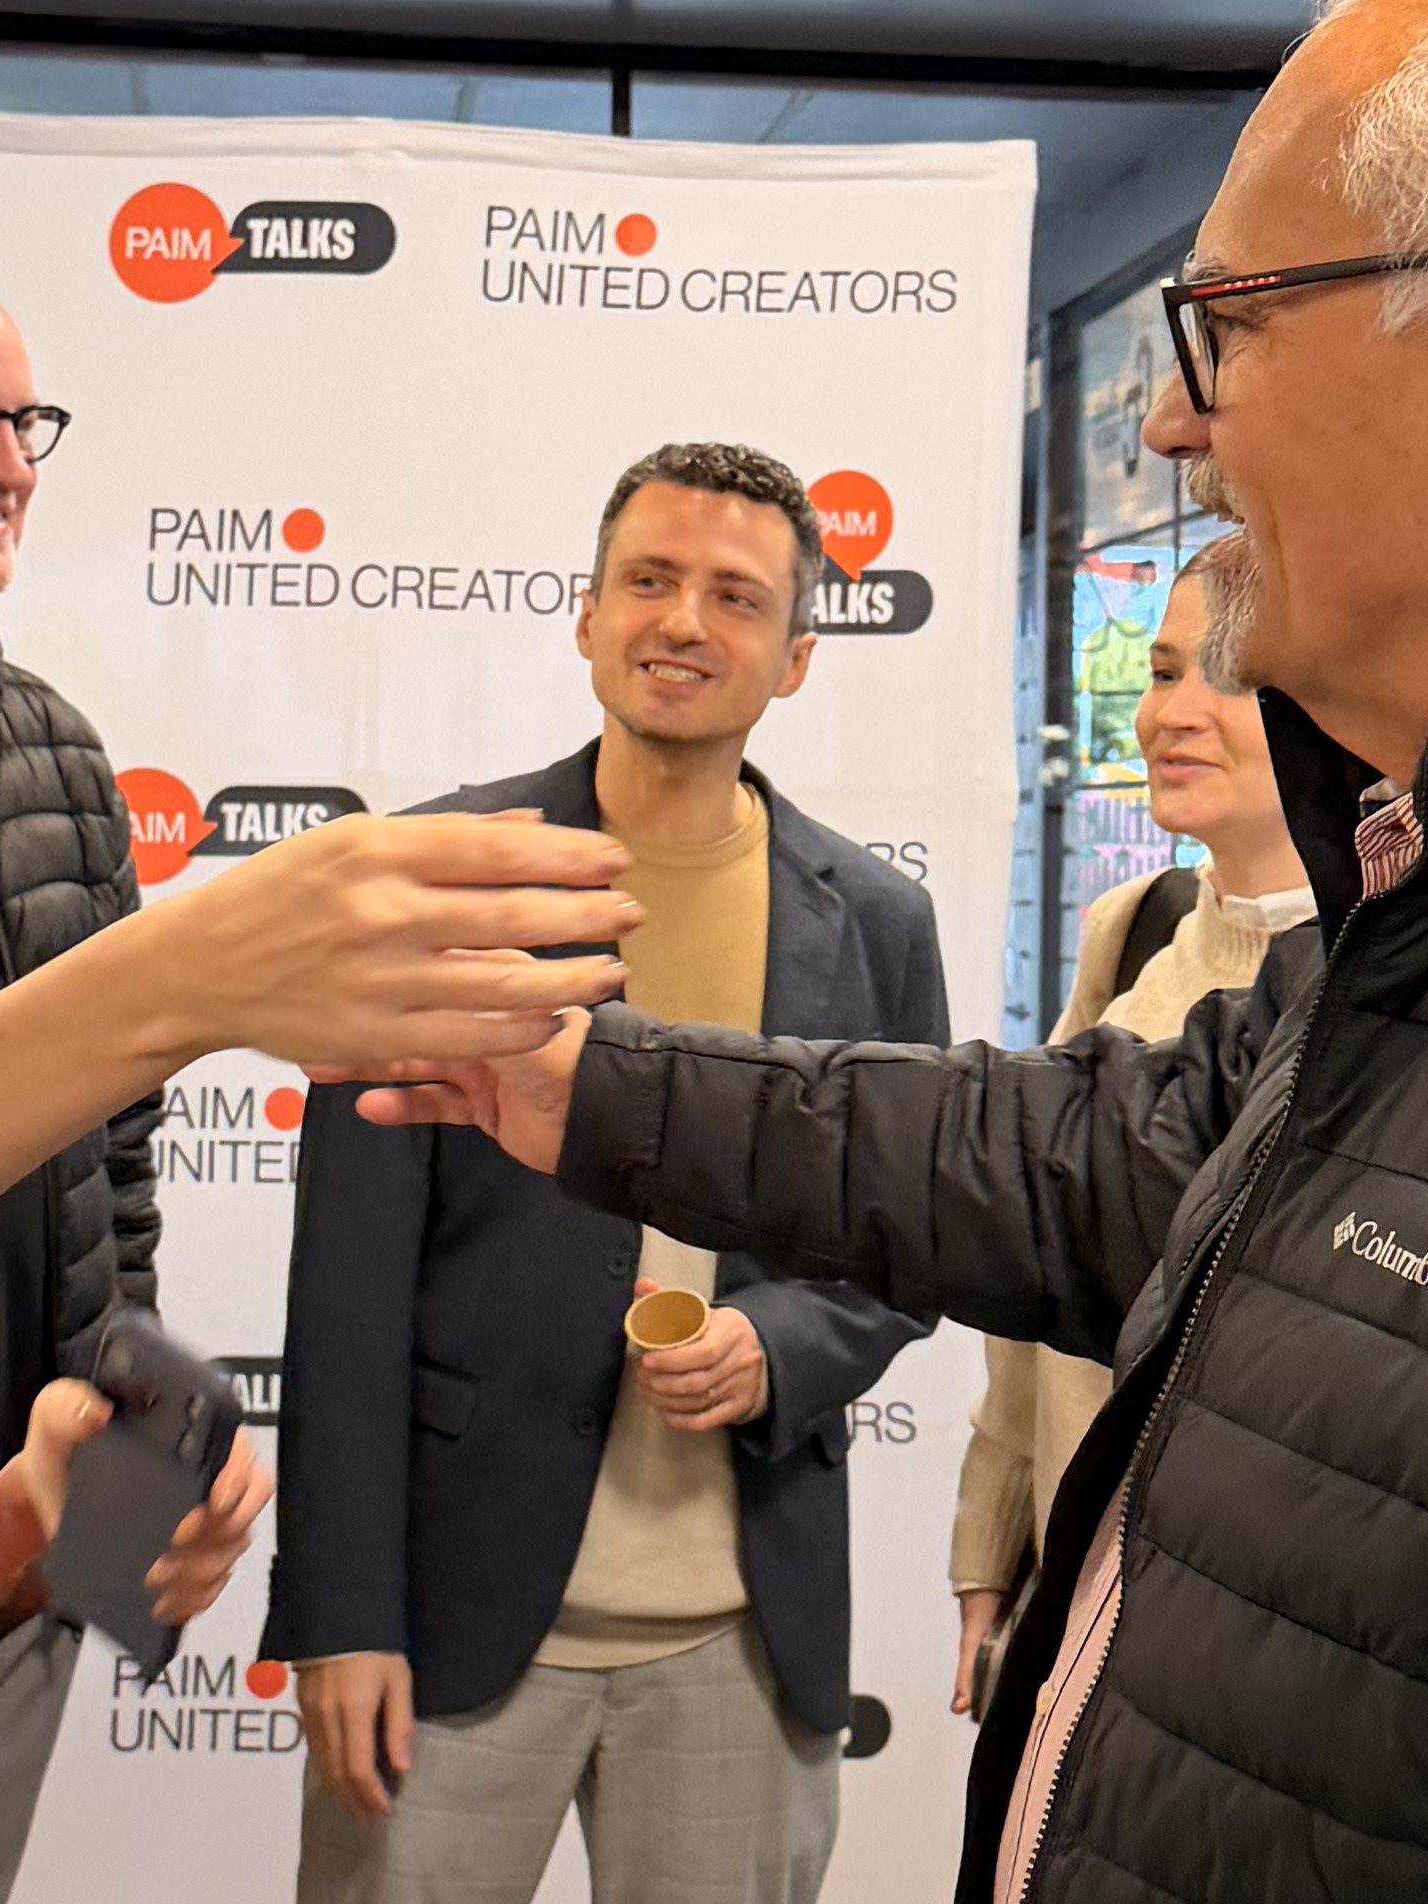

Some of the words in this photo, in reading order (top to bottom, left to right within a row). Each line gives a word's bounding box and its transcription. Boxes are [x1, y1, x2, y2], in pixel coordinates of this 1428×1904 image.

[124, 226, 212, 261] PAIM
[246, 217, 356, 261] TALKS
[484, 205, 606, 254] PAIM
[481, 257, 671, 311] UNITED
[680, 268, 958, 314] CREATORS
[148, 507, 273, 552] PAIM
[146, 561, 340, 607] UNITED
[811, 581, 895, 624] ALKS
[129, 811, 187, 843] AIM
[165, 1086, 254, 1129] AIM
[110, 1708, 305, 1752] UNITED
